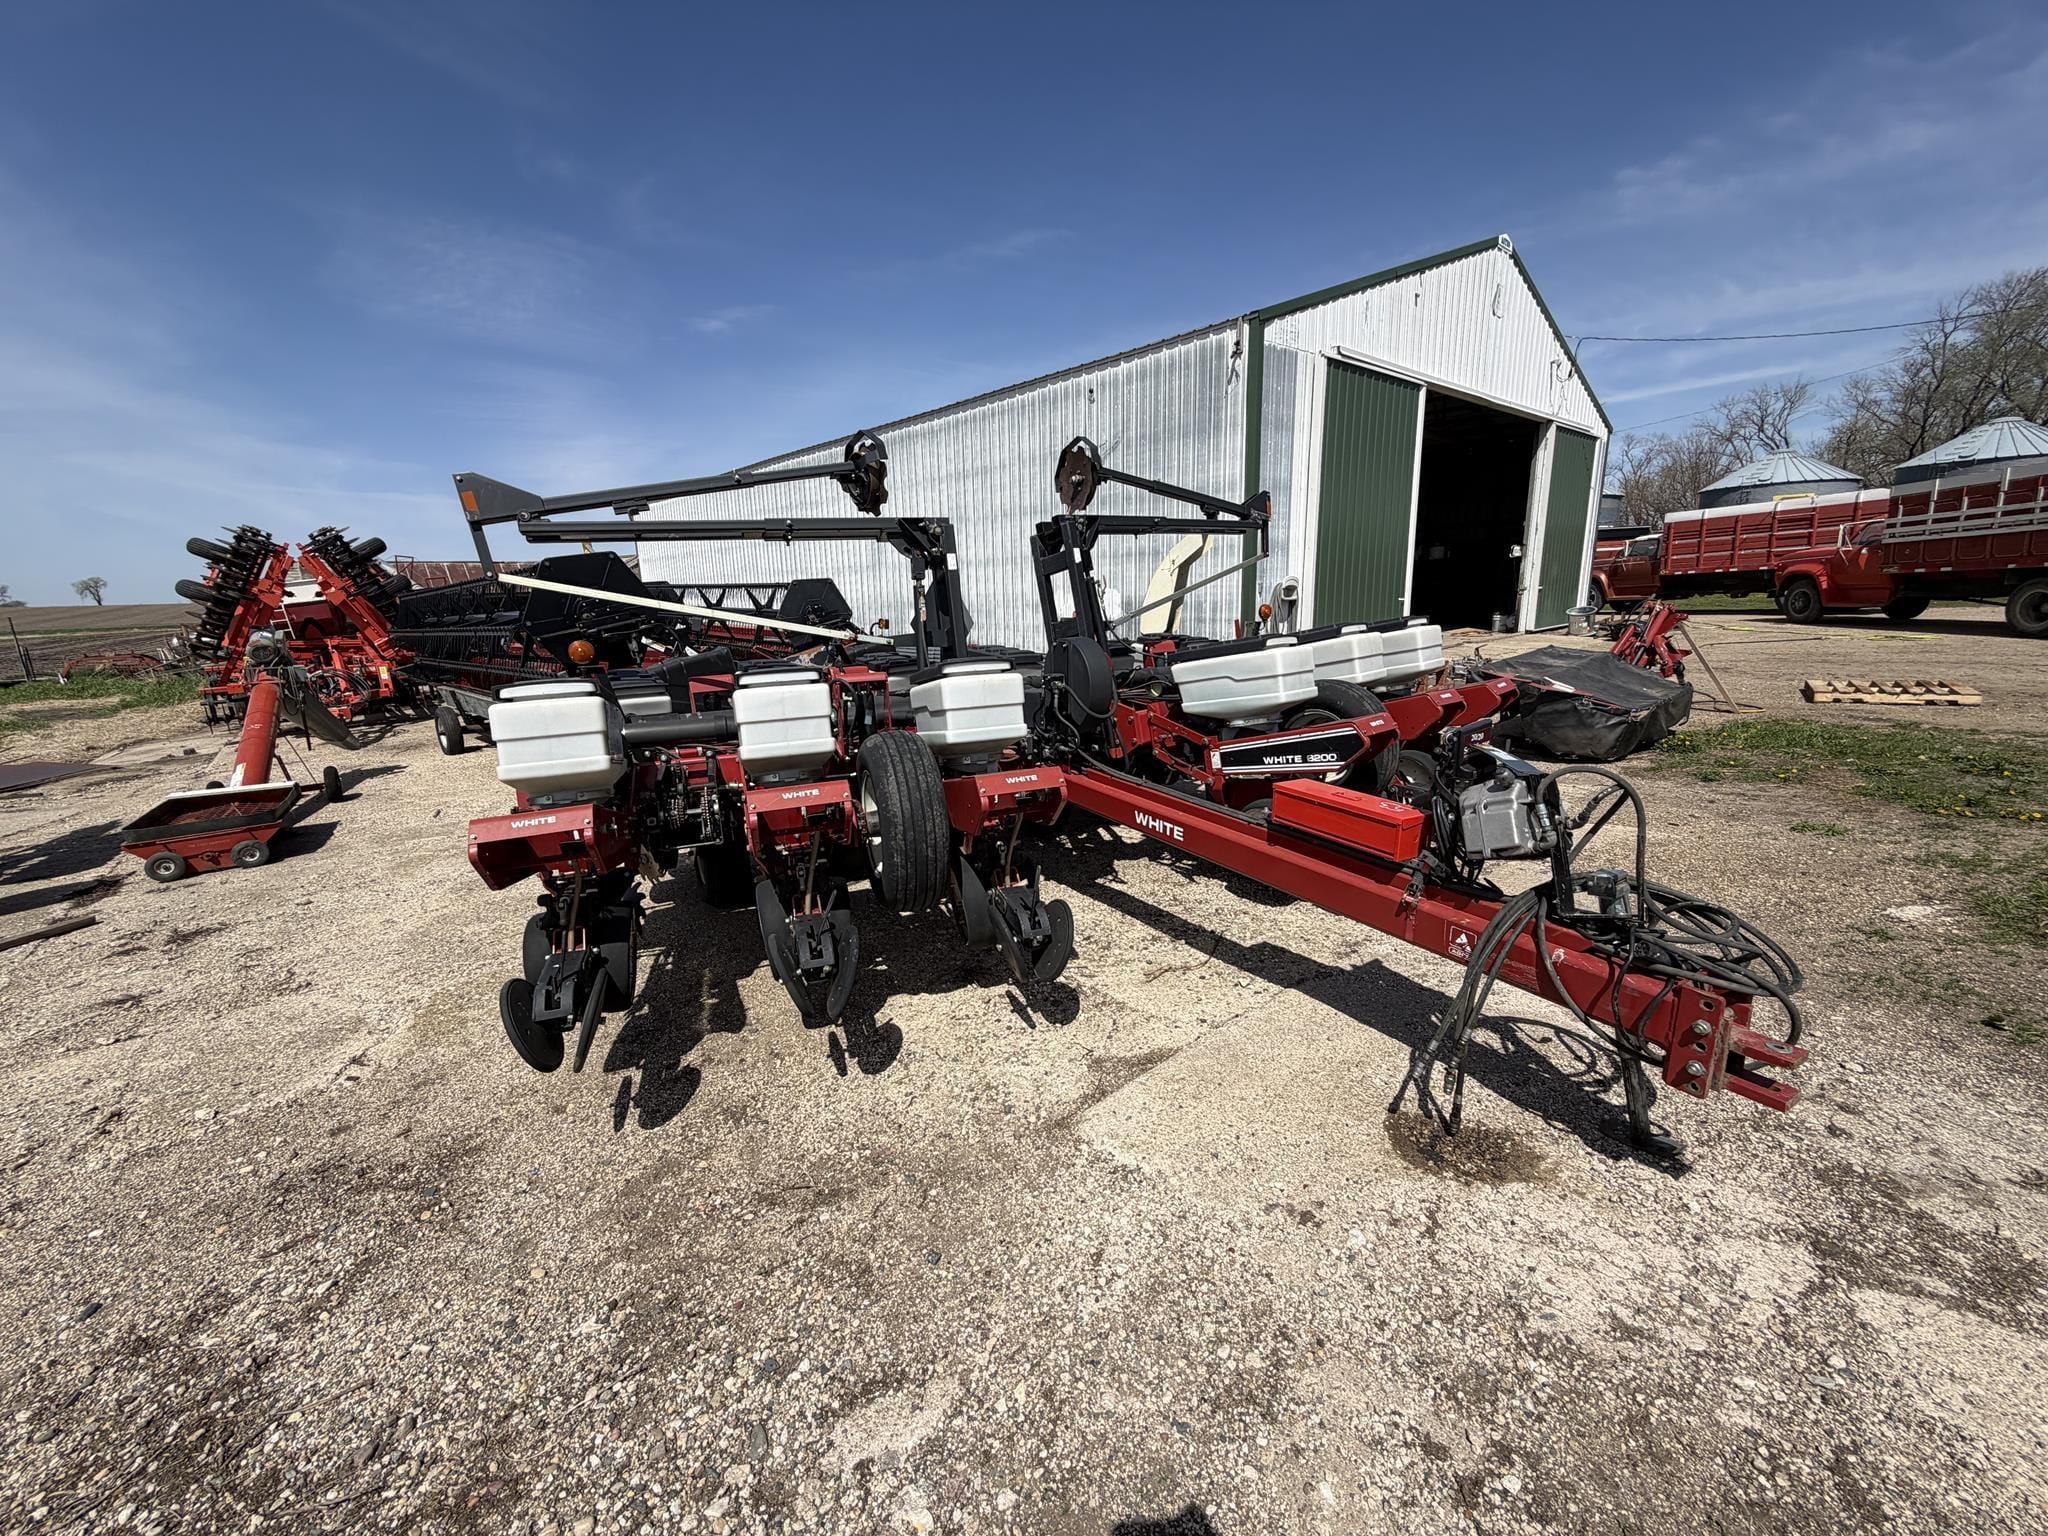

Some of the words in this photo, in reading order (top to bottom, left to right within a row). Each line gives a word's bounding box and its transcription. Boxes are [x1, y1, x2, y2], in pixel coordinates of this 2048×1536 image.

[1263, 755, 1303, 764] WHITE
[1005, 774, 1038, 784] WHITE
[782, 788, 820, 799] WHITE
[511, 815, 556, 828] WHITE
[1134, 810, 1184, 842] WHITE
